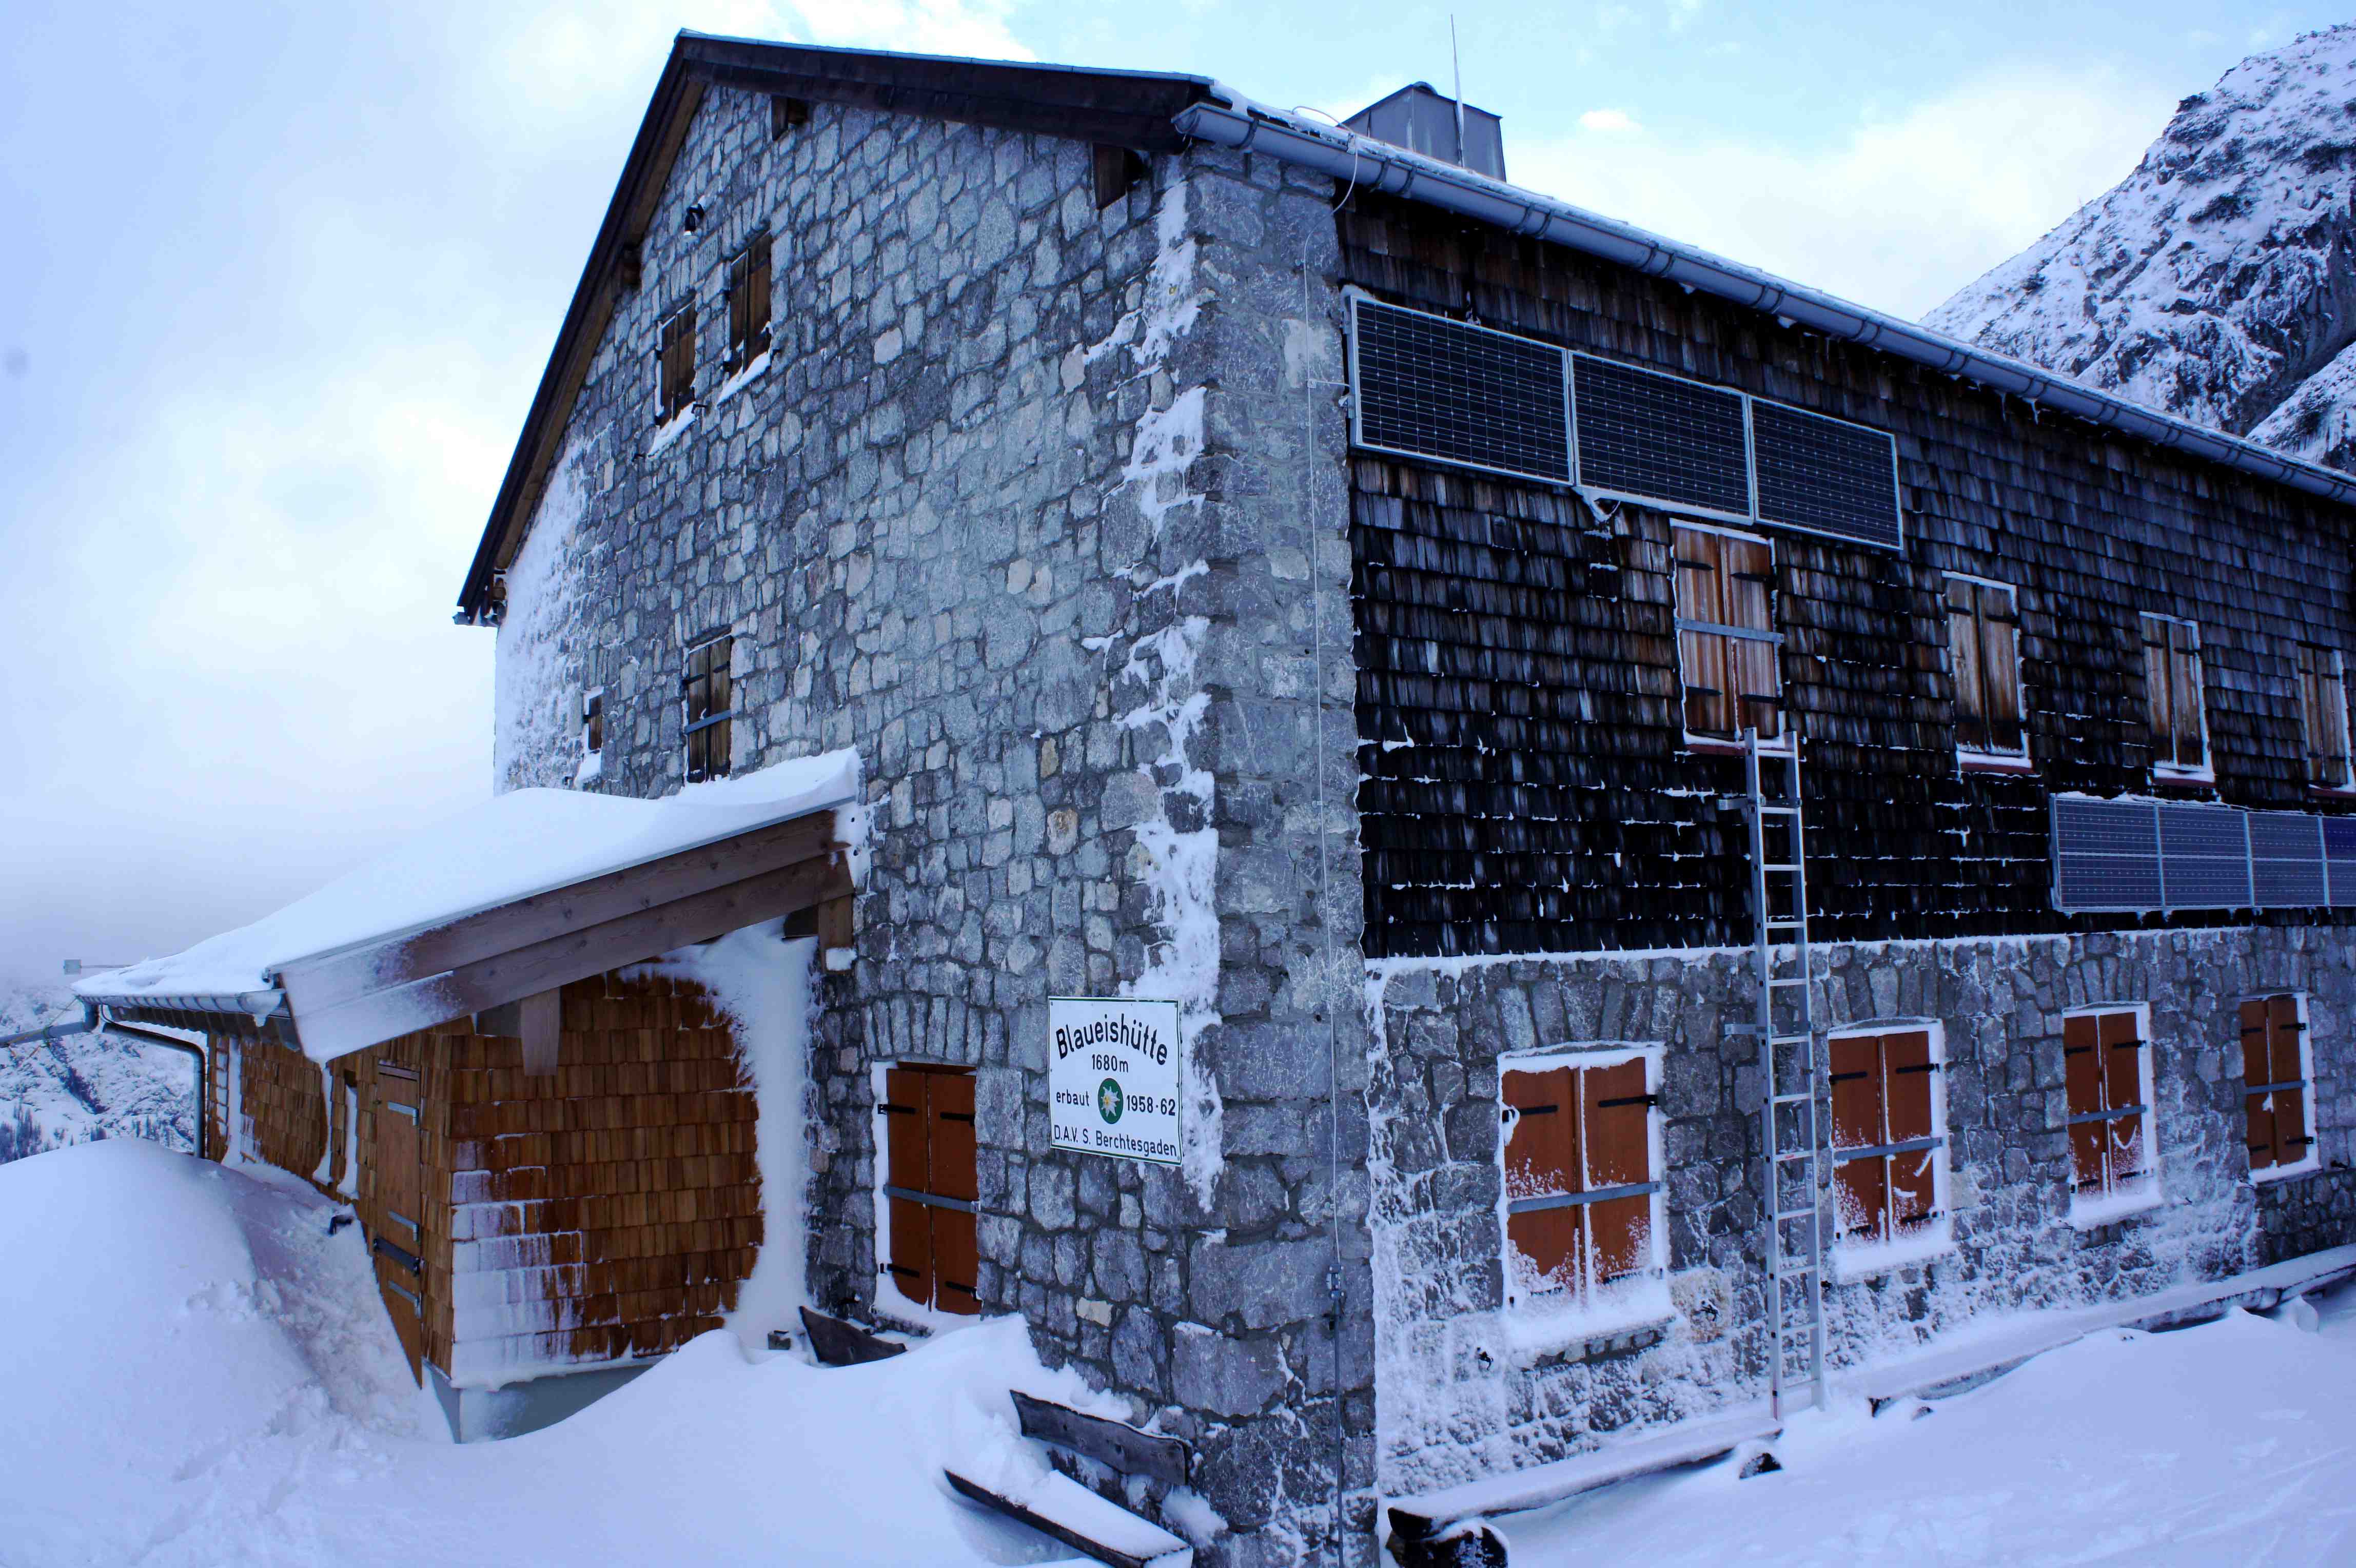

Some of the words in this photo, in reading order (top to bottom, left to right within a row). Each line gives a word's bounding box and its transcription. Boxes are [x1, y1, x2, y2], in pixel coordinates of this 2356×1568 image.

[1055, 1013, 1168, 1066] Blaueishütte
[1056, 1089, 1090, 1107] erbaut
[1054, 1124, 1078, 1143] D.A.V.
[1083, 1128, 1091, 1145] S.
[1095, 1130, 1177, 1158] Berchtesgaden
